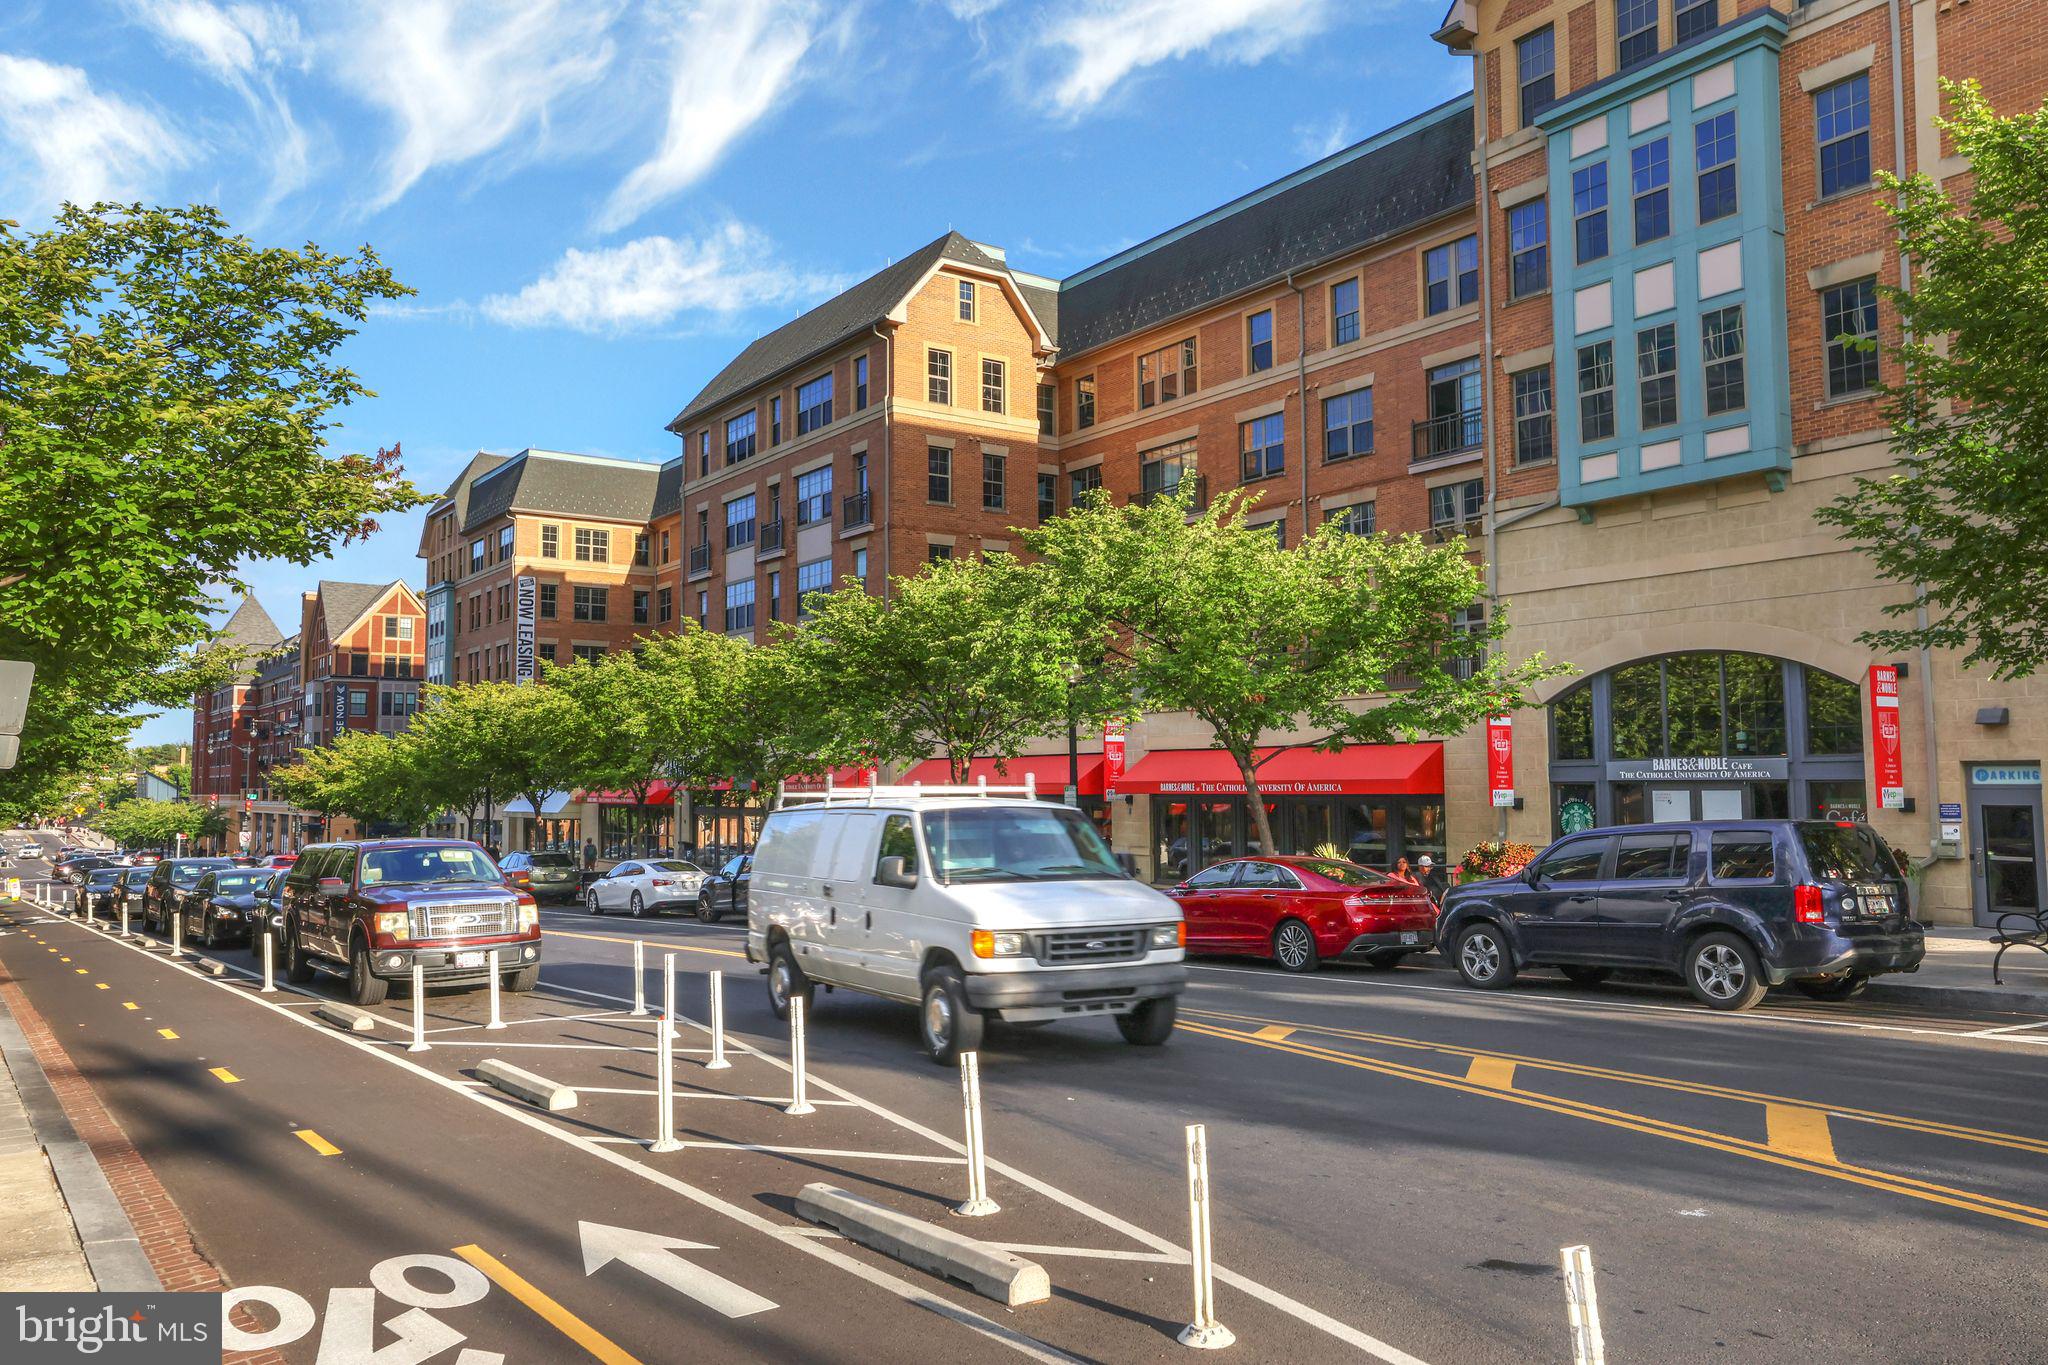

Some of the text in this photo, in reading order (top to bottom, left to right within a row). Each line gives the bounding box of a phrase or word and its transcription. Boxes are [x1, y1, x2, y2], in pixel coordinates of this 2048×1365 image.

[518, 589, 534, 620] NOW
[517, 623, 534, 677] LEASING
[1876, 670, 1896, 682] BARNES
[336, 695, 345, 719] NOW
[1731, 761, 1753, 770] CAFE
[1619, 770, 1771, 779] THE CATHOLIC UNIVERSITY OF AMERICA
[1975, 768, 2040, 782] PARKING
[1201, 782, 1215, 792] THE
[1216, 782, 1248, 792] CATHOLI
[1256, 783, 1293, 792] NIVERSITY
[1294, 782, 1306, 792] OF
[1306, 782, 1342, 792] AMERICA
